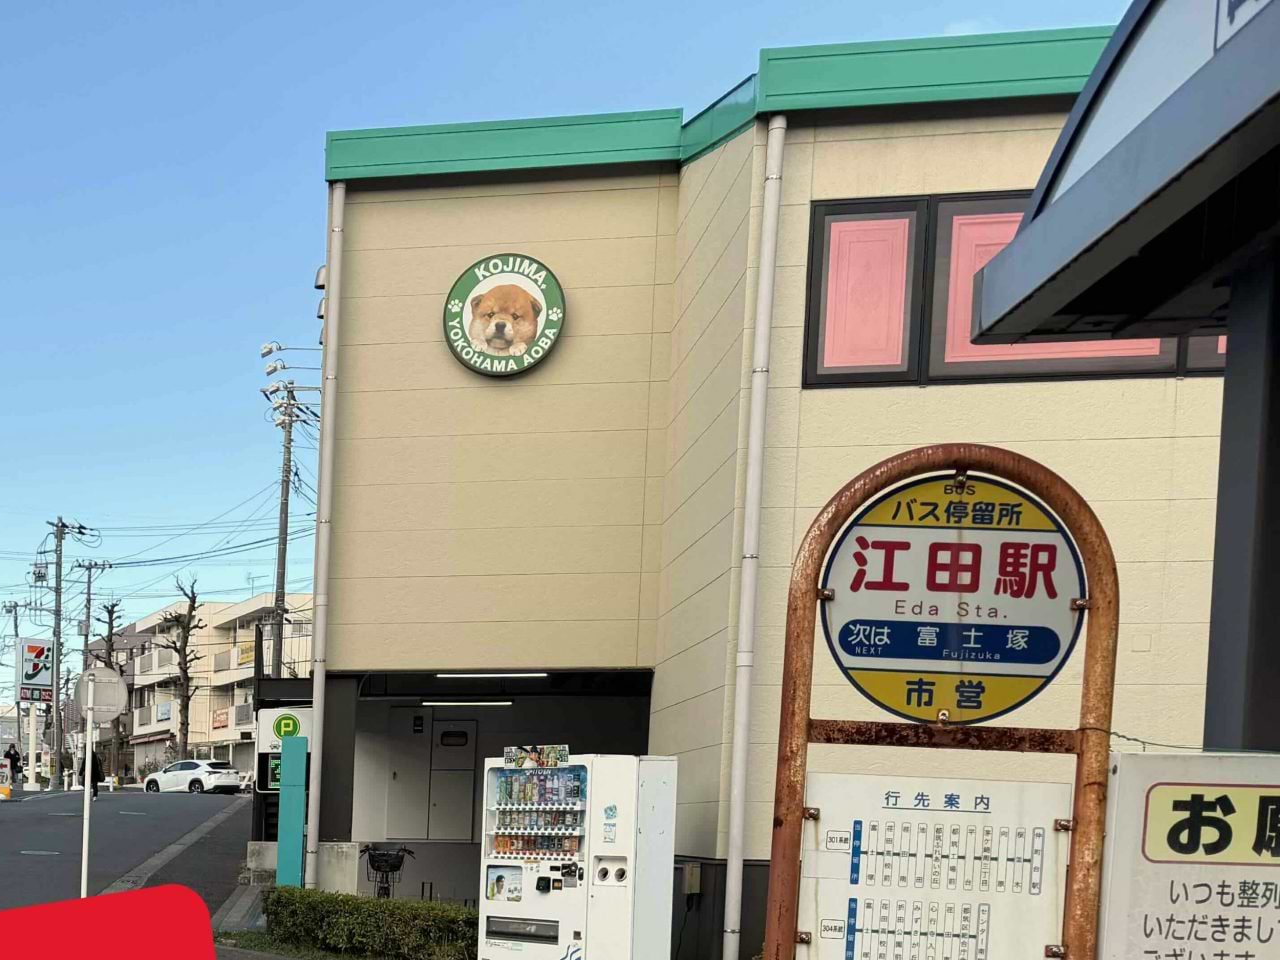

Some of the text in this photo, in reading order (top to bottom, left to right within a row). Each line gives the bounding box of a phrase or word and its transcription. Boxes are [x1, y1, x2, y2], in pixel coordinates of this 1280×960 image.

[474, 257, 547, 286] KOJIMA
[449, 317, 557, 372] YOKOHAMA AOBA
[891, 498, 1023, 526] バス停留所
[849, 535, 1058, 600] 江田駅
[895, 600, 1008, 619] Eda Sta.
[848, 624, 1029, 650] 次は 富士塚
[855, 646, 1001, 661] NEXT Fujizuka
[906, 678, 986, 710] 市営
[281, 720, 293, 736] P
[884, 790, 991, 811] 行先案内
[1170, 880, 1280, 909] いつも整列
[1144, 913, 1280, 944] いただきまし
